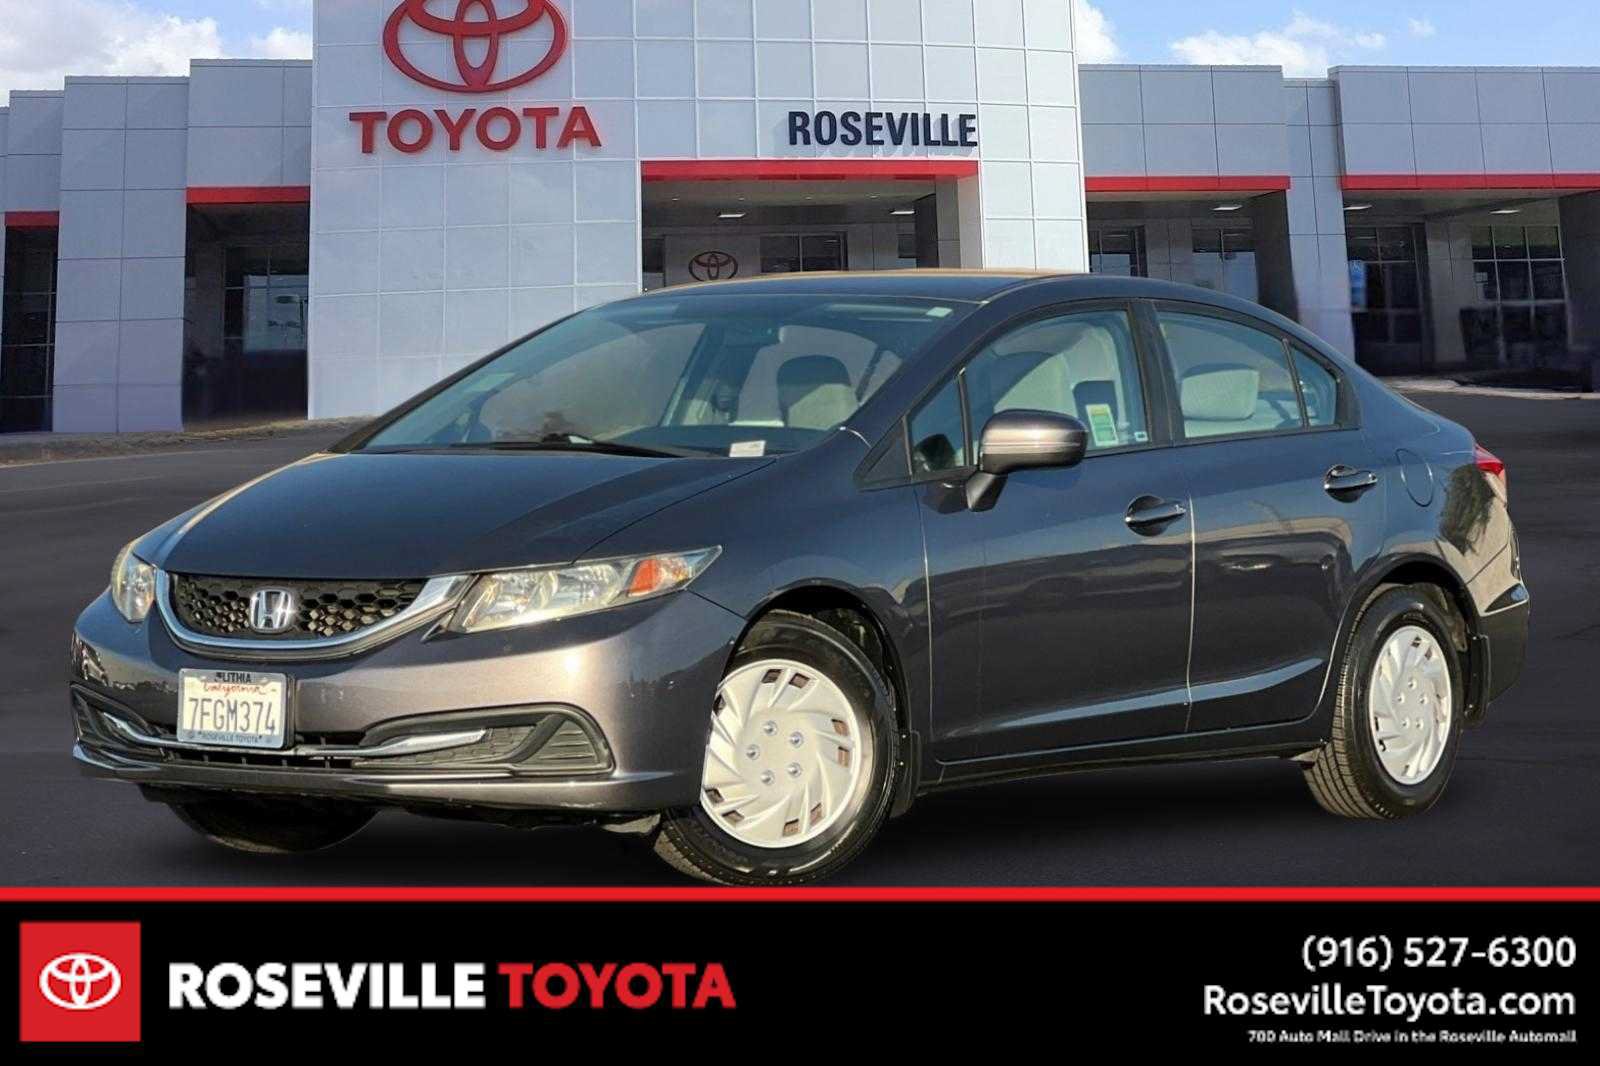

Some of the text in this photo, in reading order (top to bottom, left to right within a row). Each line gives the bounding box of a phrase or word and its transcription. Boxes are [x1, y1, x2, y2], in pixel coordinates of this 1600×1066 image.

[349, 106, 603, 154] TOYOTA
[787, 110, 978, 147] ROSEVILLE
[221, 671, 252, 683] LITHIA
[188, 697, 277, 736] 7FGM374
